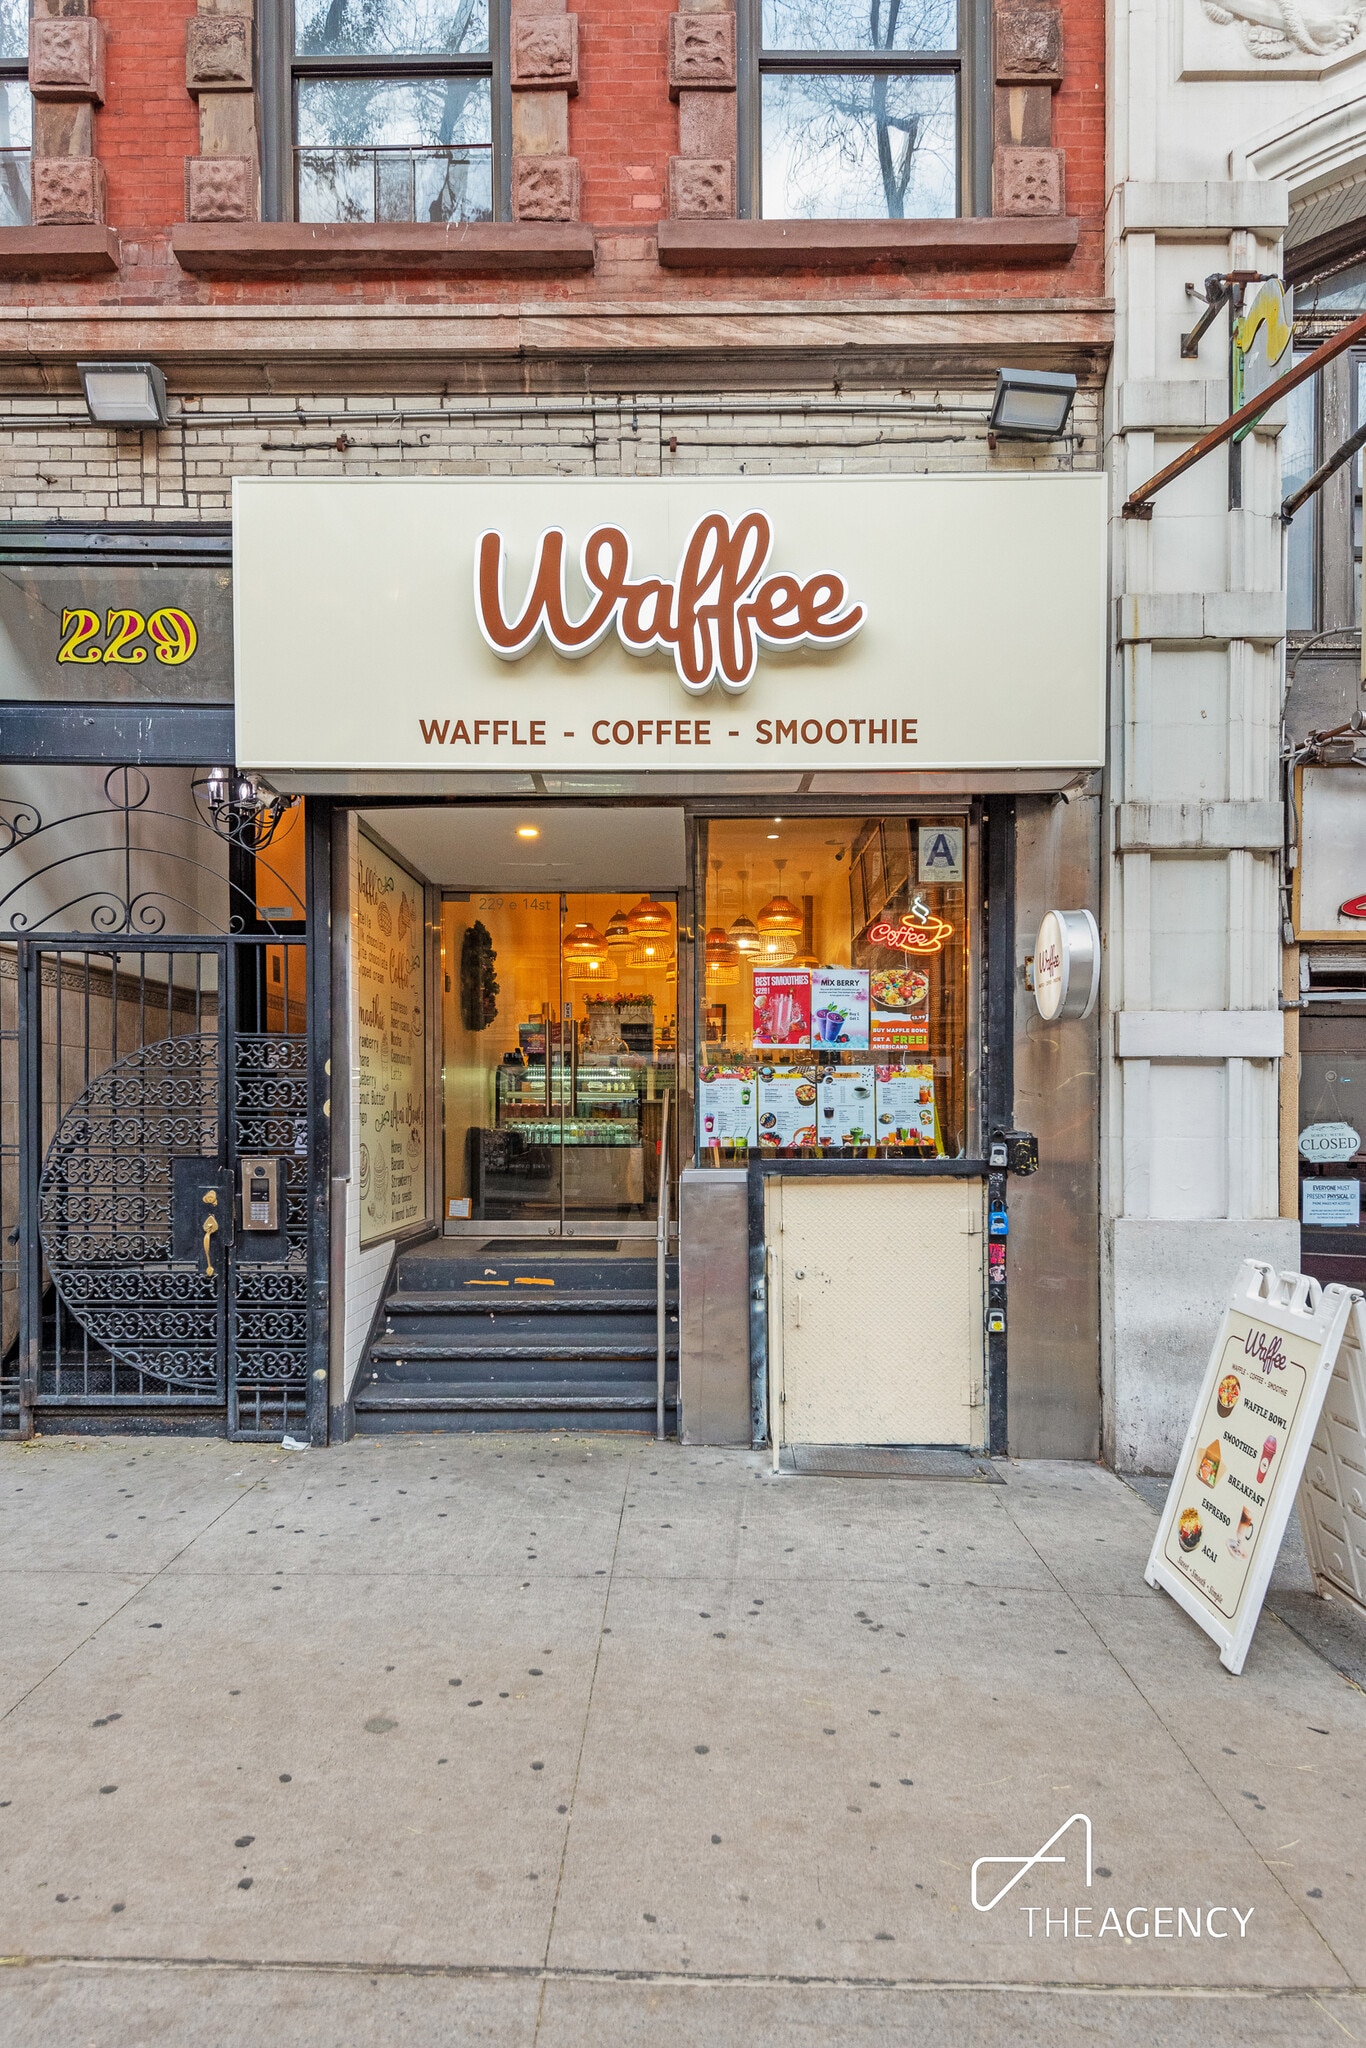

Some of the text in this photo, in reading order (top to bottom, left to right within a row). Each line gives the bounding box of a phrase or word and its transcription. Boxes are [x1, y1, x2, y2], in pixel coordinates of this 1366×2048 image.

[475, 508, 868, 692] Waffee
[56, 606, 198, 666] 229
[419, 719, 546, 745] WAFFLE
[592, 719, 711, 745] COFFEE
[755, 719, 918, 745] SMOOTHIE
[926, 834, 955, 866] A
[479, 898, 551, 910] 229 e 14st
[871, 924, 928, 948] Coffee
[390, 948, 408, 990] Coffee
[755, 975, 809, 986] BEST SMOOTHIES
[893, 1035, 927, 1044] FREE!
[1301, 1138, 1358, 1150] CLOSED
[1245, 1328, 1287, 1375] Waffee
[1232, 1363, 1288, 1397] WAFFLE COFFEE SMOOTHIE
[1243, 1398, 1287, 1430] WAFFLE BOWL
[1223, 1431, 1258, 1459] SMOOTHIES
[1227, 1474, 1265, 1507] BREAKFAST
[1201, 1498, 1231, 1527] ESPRESSO
[1202, 1544, 1218, 1563] ACAI
[1177, 1556, 1223, 1604] Sweet Smooth Simple
